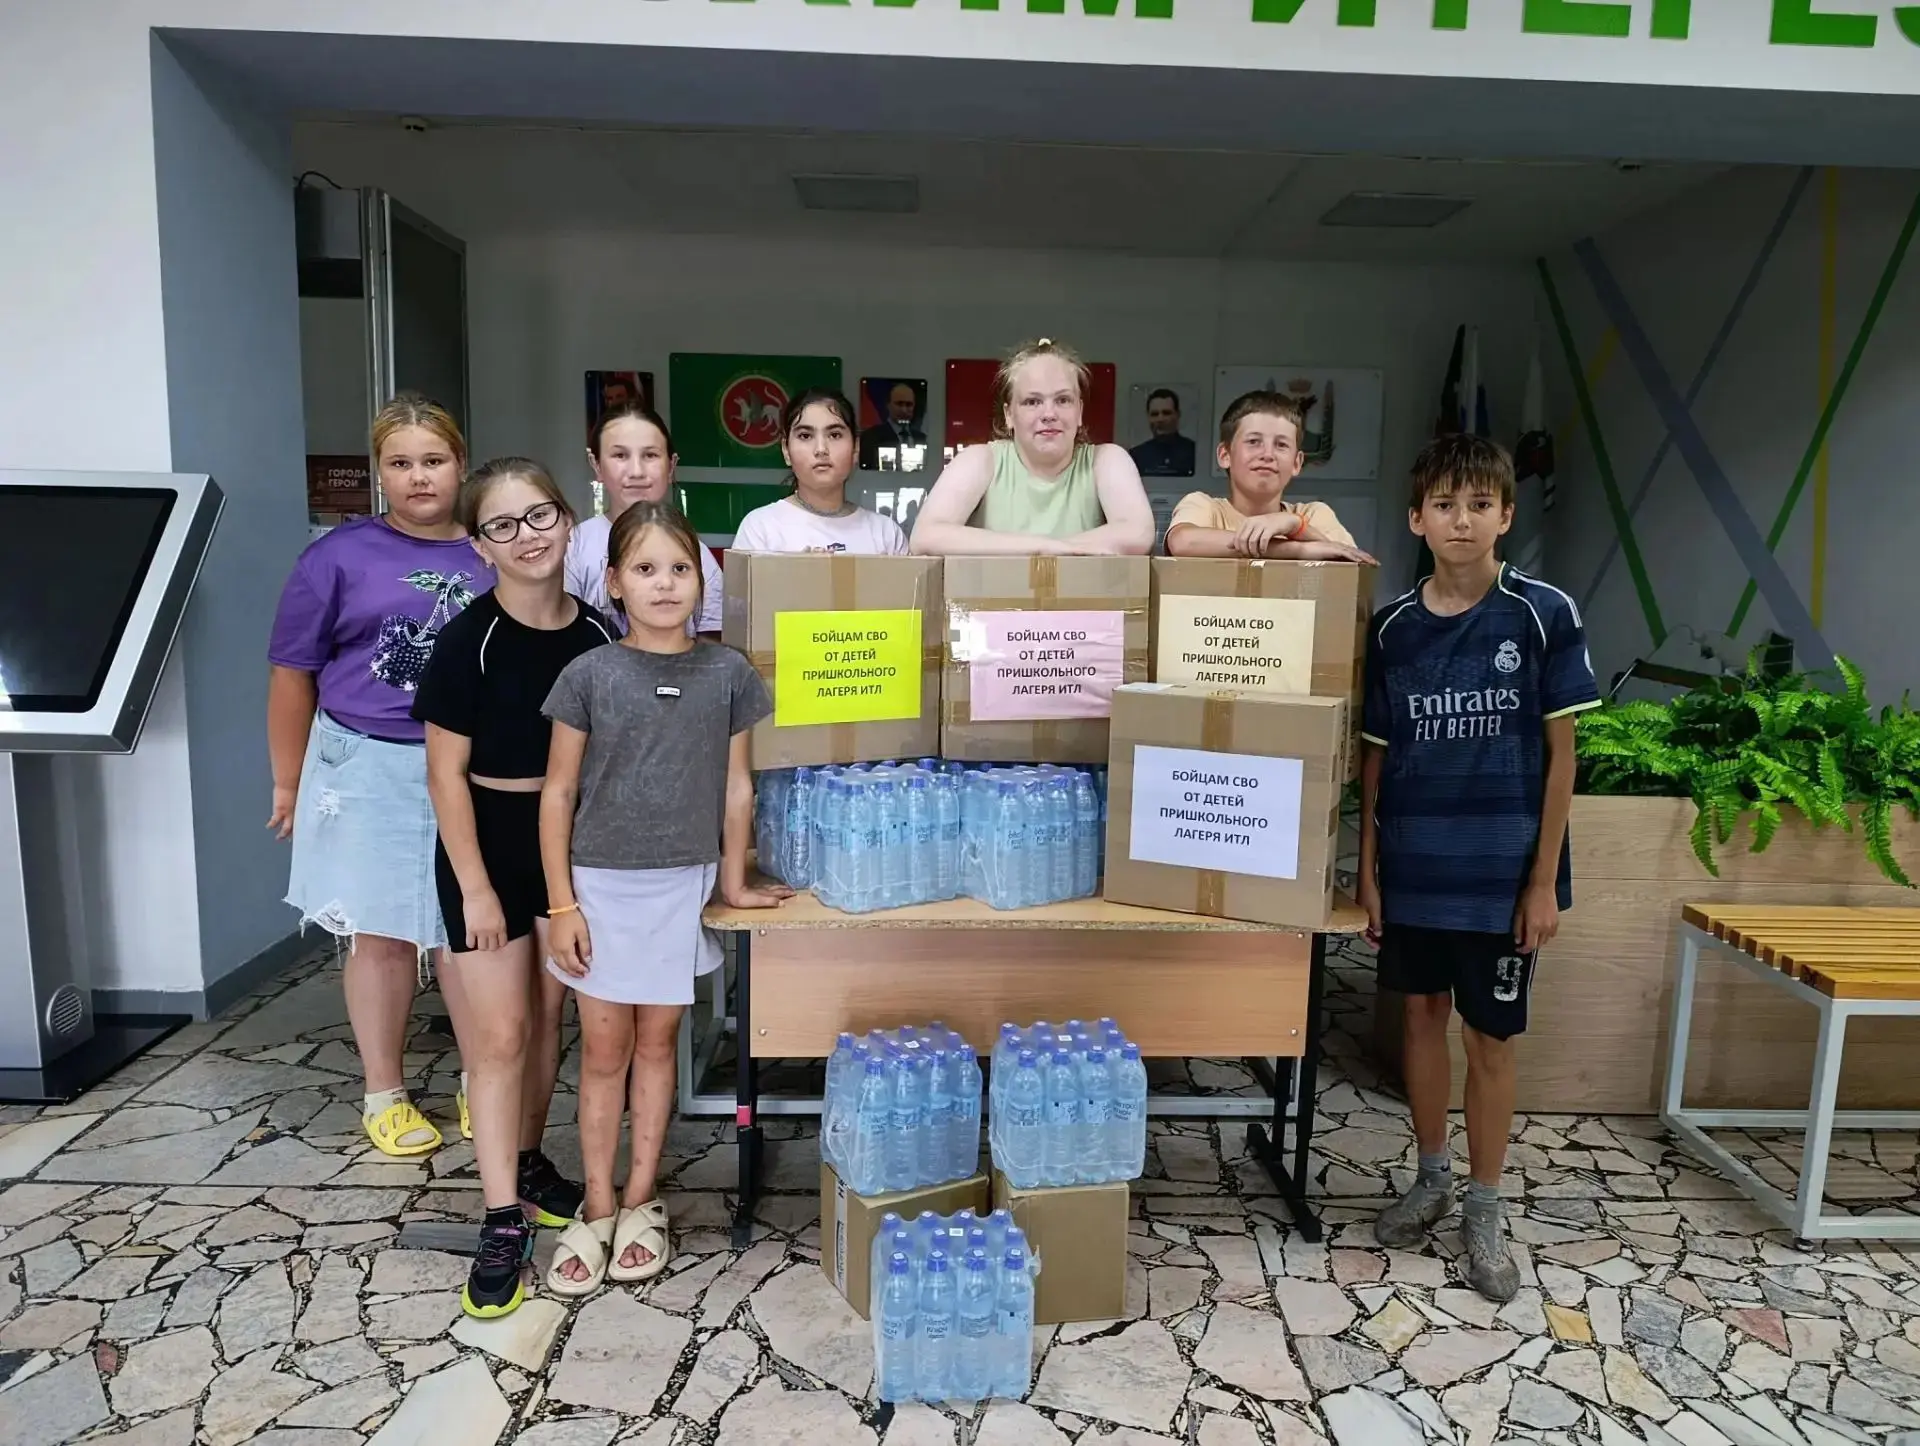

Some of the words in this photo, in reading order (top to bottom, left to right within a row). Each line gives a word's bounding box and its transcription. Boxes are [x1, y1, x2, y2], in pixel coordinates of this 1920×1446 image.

[1193, 615, 1246, 630] БОЙЦАМ
[1249, 619, 1274, 630] СВО
[812, 630, 863, 644] БОЙЦАМ
[866, 631, 888, 641] СВО
[1007, 629, 1061, 643] БОЙЦАМ
[1063, 631, 1087, 641] СВО
[1204, 636, 1220, 647] ОТ
[1221, 636, 1260, 649] ДЕТЕЙ
[824, 651, 840, 662] ОТ
[841, 648, 876, 663] ДЕТЕЙ
[1019, 650, 1035, 661] ОТ
[1037, 648, 1075, 662] ДЕТЕЙ
[1182, 653, 1283, 669] ПРИШКОЛЬНОГО
[802, 666, 897, 681] ПРИШКОЛЬНОГО
[997, 666, 1097, 678] ПРИШКОЛЬНОГО
[1195, 671, 1239, 684] ЛАГЕРЯ
[1241, 674, 1266, 685] ИТЛ
[816, 685, 858, 698] ЛАГЕРЯ
[860, 684, 882, 695] ИТЛ
[1011, 684, 1056, 695] ЛАГЕРЯ
[1058, 684, 1083, 694] ИТЛ
[1415, 719, 1441, 741] FLY
[1447, 715, 1502, 739] BETTER
[1172, 769, 1229, 786] БОЙЦАМ
[1232, 776, 1259, 789] СВО
[1183, 791, 1201, 803] ОТ
[1202, 792, 1244, 807] ДЕТЕЙ
[1160, 807, 1269, 829] ПРИШКОЛЬНОГО
[1173, 827, 1221, 842] ЛАГЕРЯ
[1224, 833, 1250, 846] ИТЛ
